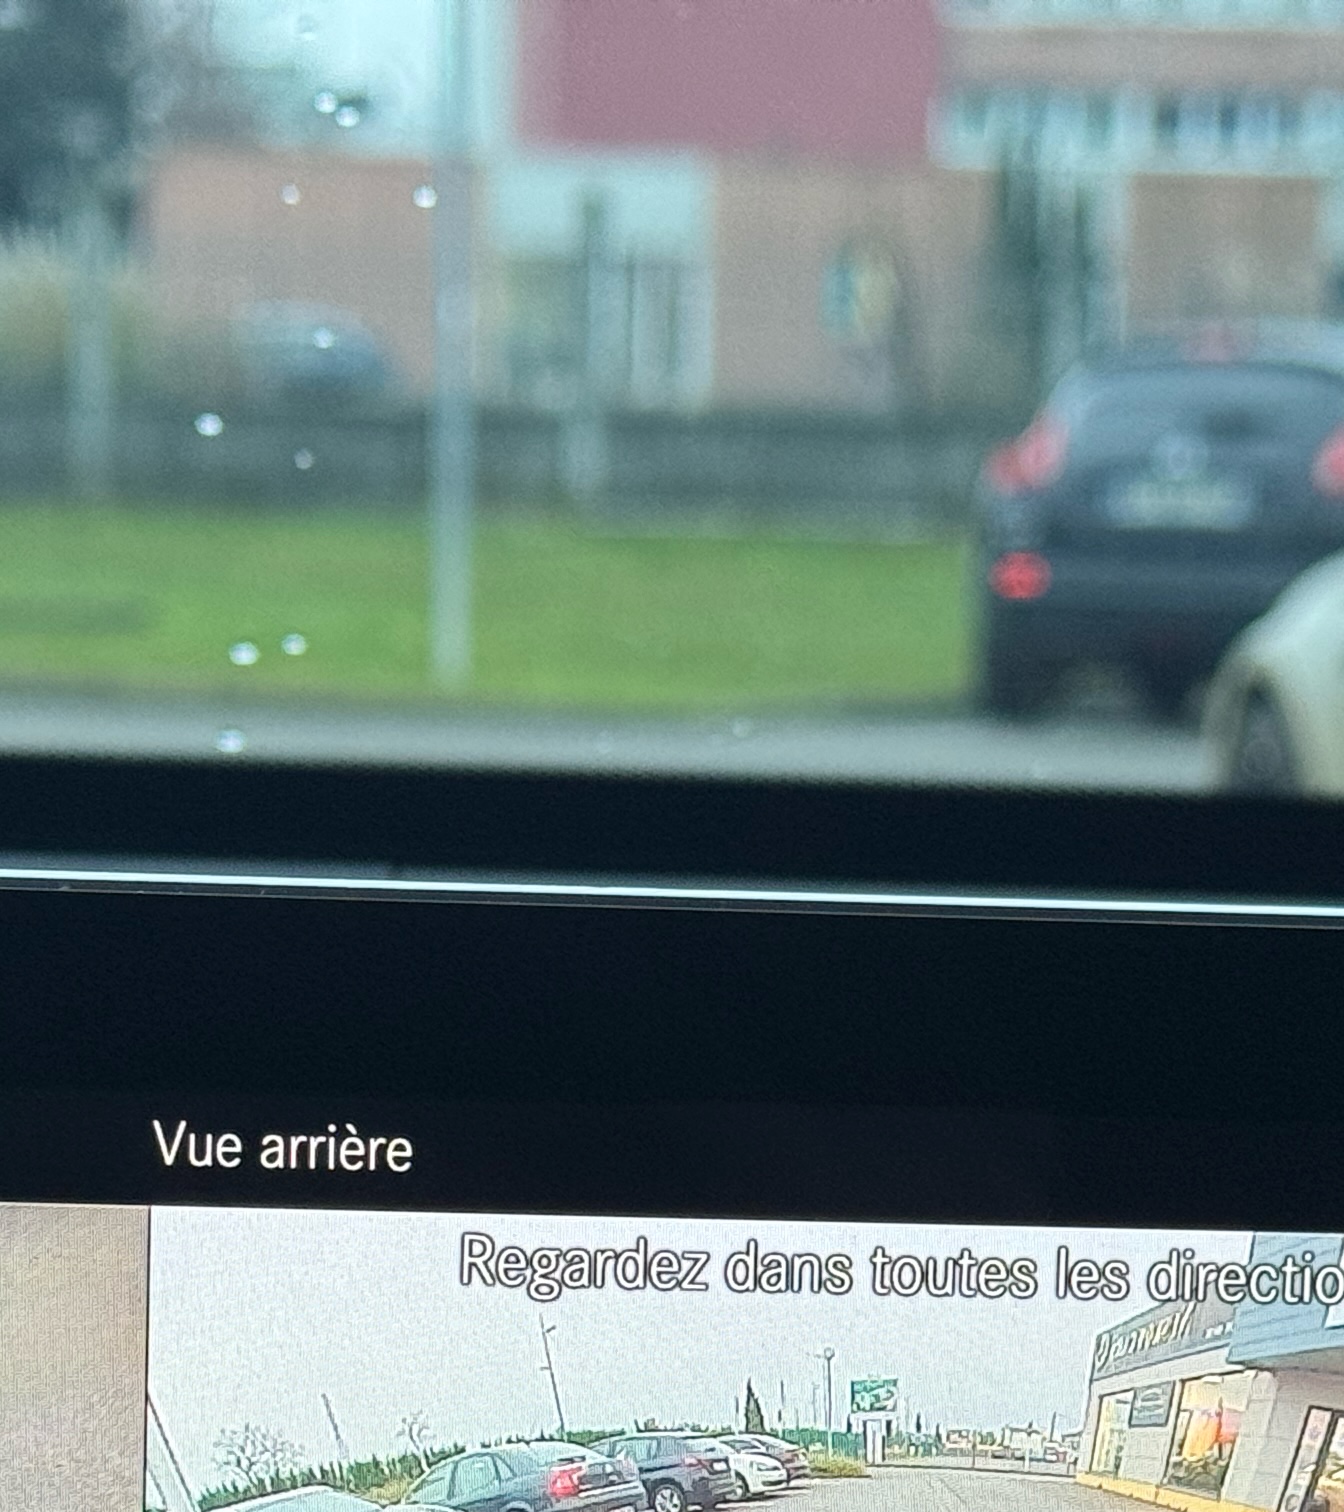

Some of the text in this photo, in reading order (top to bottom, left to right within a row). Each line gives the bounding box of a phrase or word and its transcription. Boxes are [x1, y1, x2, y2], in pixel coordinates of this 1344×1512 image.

[152, 1119, 414, 1173] Vue arrière
[459, 1232, 710, 1301] Regardez
[724, 1238, 854, 1295] dans
[870, 1246, 1038, 1298] toutes
[1055, 1247, 1130, 1301] les
